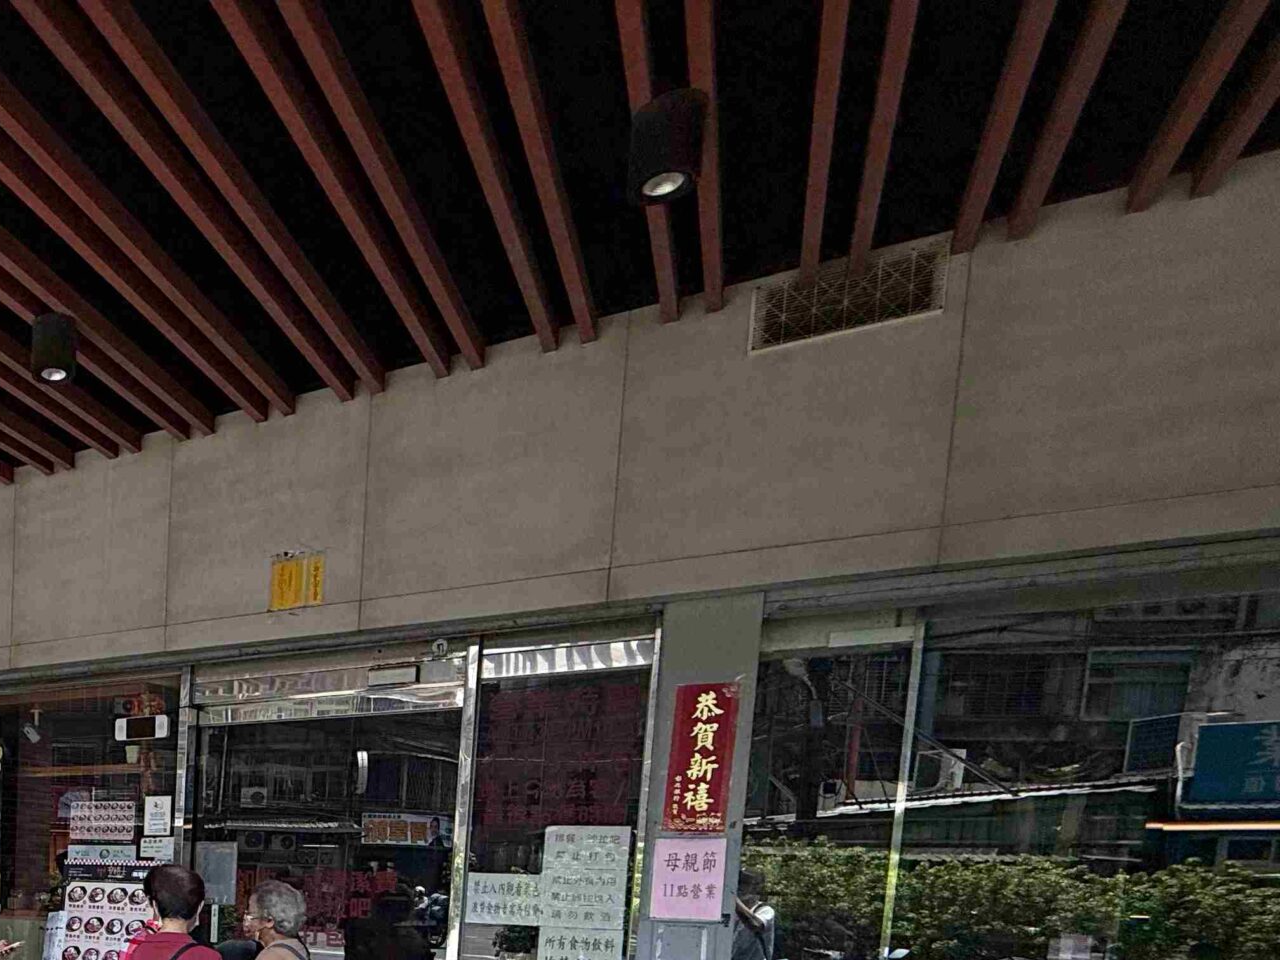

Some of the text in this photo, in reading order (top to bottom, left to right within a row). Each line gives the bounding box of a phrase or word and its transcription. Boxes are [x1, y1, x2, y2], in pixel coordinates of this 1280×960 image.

[682, 691, 724, 812] 恭賀新禧
[664, 851, 717, 872] 母親節
[663, 883, 717, 899] 11點營業
[545, 935, 615, 953] 所有食物飲料
